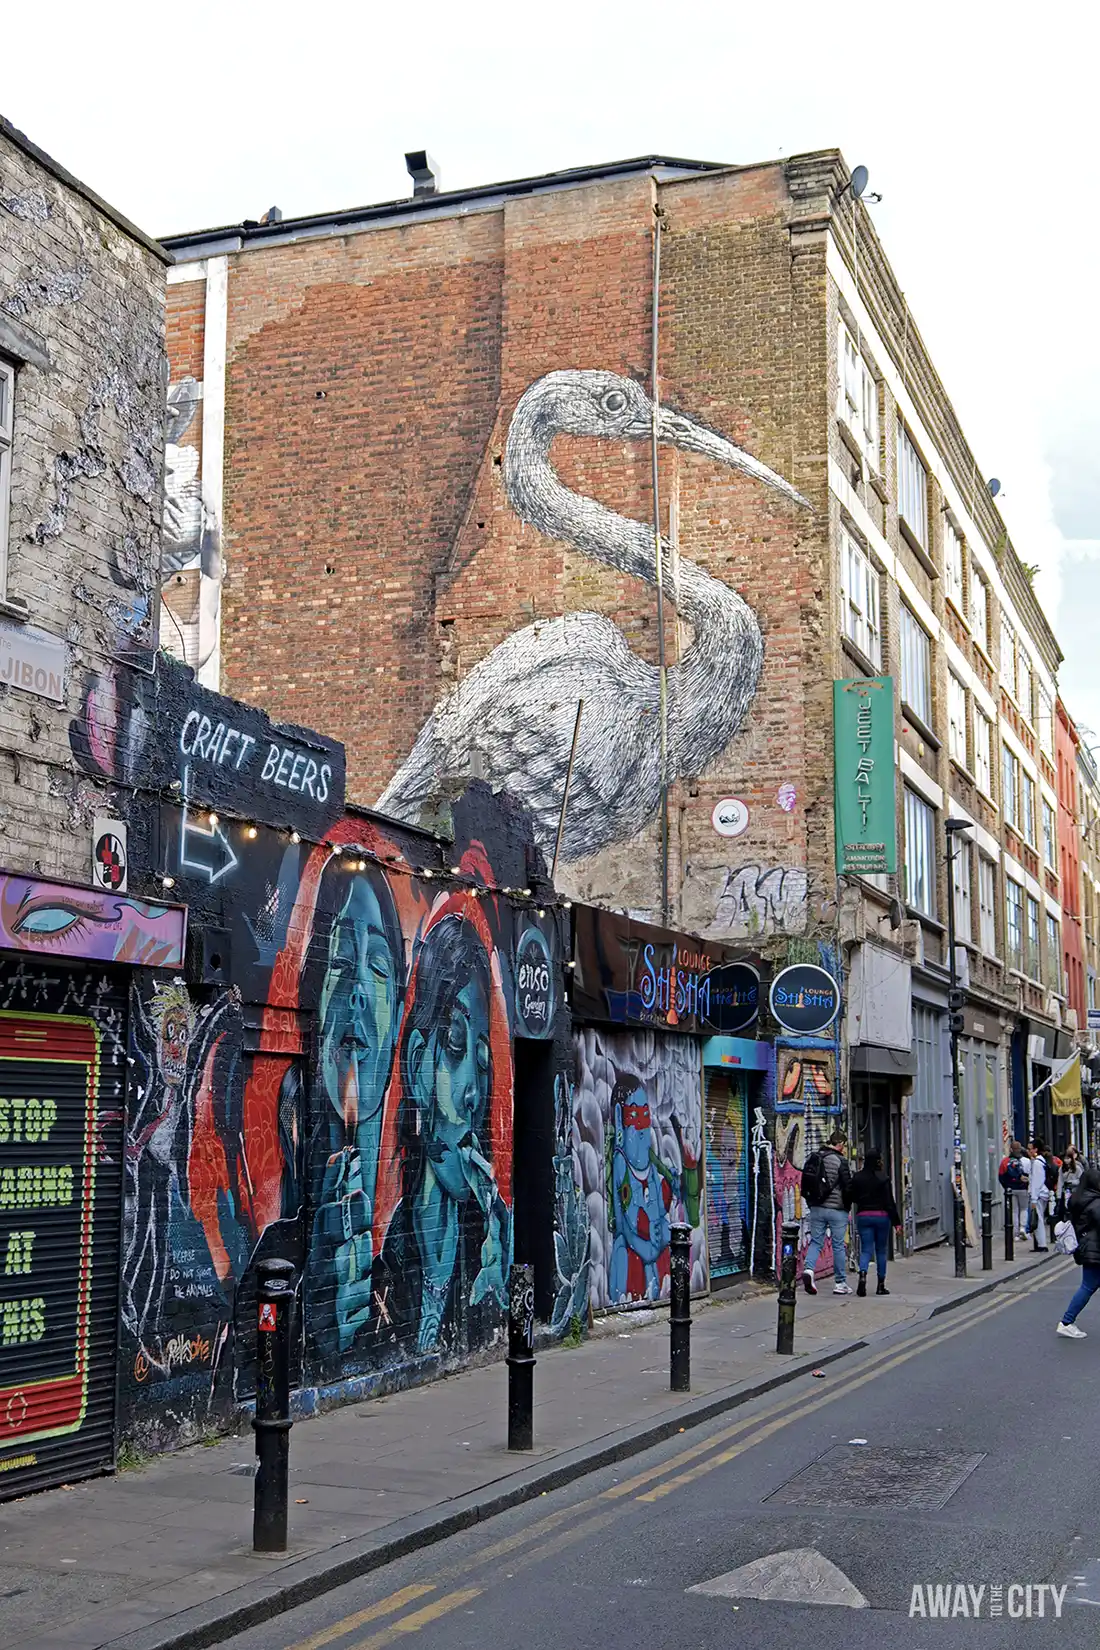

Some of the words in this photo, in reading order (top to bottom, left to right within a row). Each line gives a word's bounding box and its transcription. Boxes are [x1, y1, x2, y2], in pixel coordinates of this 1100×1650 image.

[1, 657, 62, 698] JIBON
[857, 696, 872, 753] JEET
[180, 710, 256, 769] CRAFT
[261, 743, 332, 802] BEERS
[854, 757, 875, 825] BALTI
[677, 949, 712, 972] LOUNGE
[640, 943, 711, 1024] SHISHA
[804, 988, 833, 996] LOUNGE
[0, 1098, 57, 1142] STOP
[0, 1164, 74, 1209] ARING
[5, 1231, 36, 1275] AT
[0, 1298, 46, 1345] HIS
